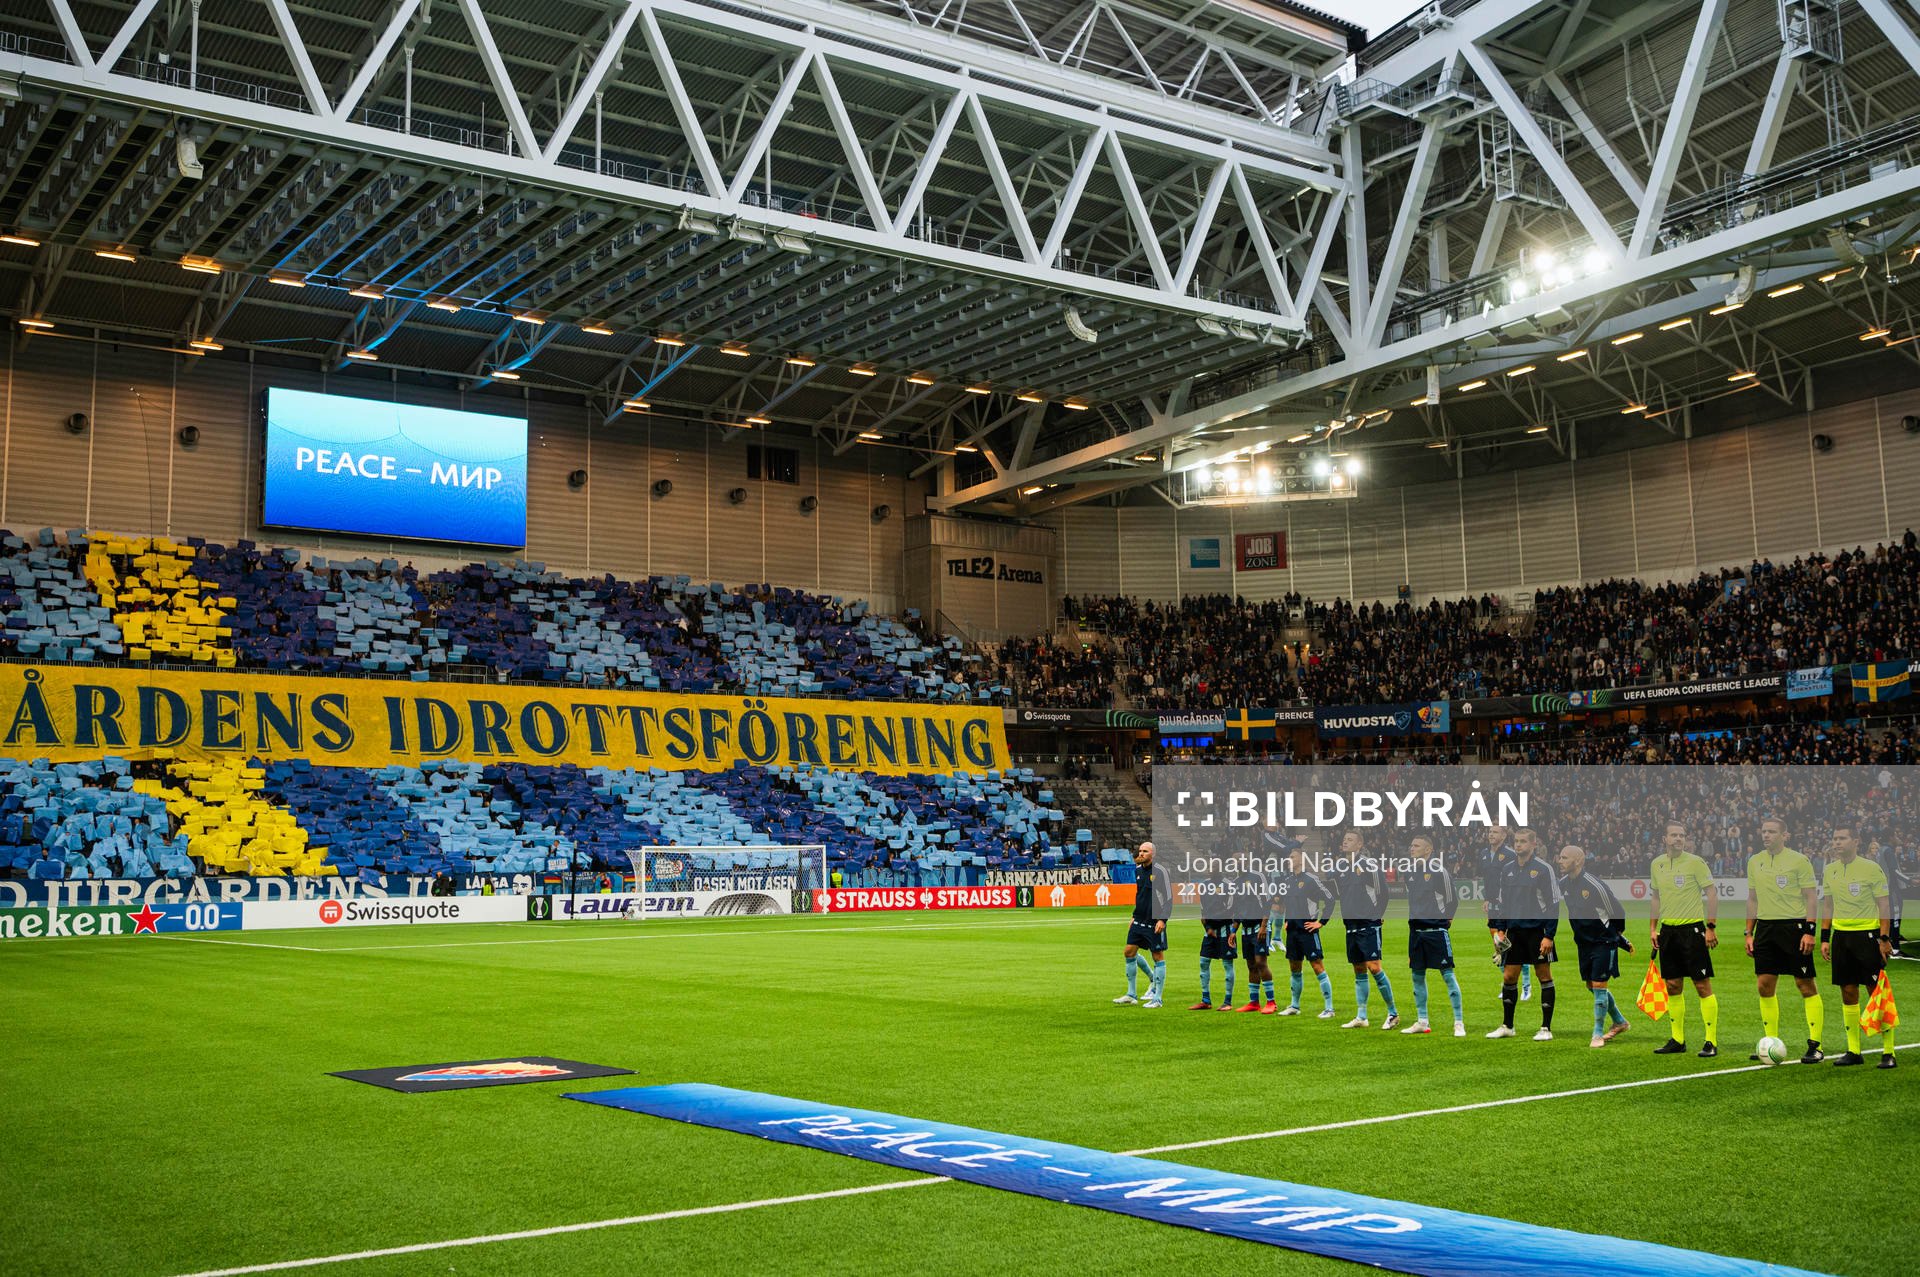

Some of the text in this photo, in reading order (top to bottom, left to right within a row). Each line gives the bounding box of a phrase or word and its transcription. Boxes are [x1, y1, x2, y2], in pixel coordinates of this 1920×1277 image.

[296, 447, 397, 480] PEACE
[430, 462, 501, 490] МИР
[1247, 537, 1272, 555] JOB
[947, 557, 1043, 584] TELE2 Arena
[1245, 556, 1278, 568] ZONE
[1907, 660, 1920, 673] vi
[1623, 676, 1781, 700] UEFA EUROPA CONFERENCE LEAGUE
[3, 669, 997, 770] ÅRDENS IDROTTSFÖRENING
[1032, 711, 1071, 721] Swissquote
[1159, 711, 1222, 726] DJURGÅRDEN
[1274, 711, 1314, 720] FERENCE
[1323, 715, 1396, 728] HUVUDSTA
[836, 889, 1012, 909] STRAUSS STRAUSS
[346, 901, 460, 924] Swissquote
[759, 1114, 1052, 1168] PEACE
